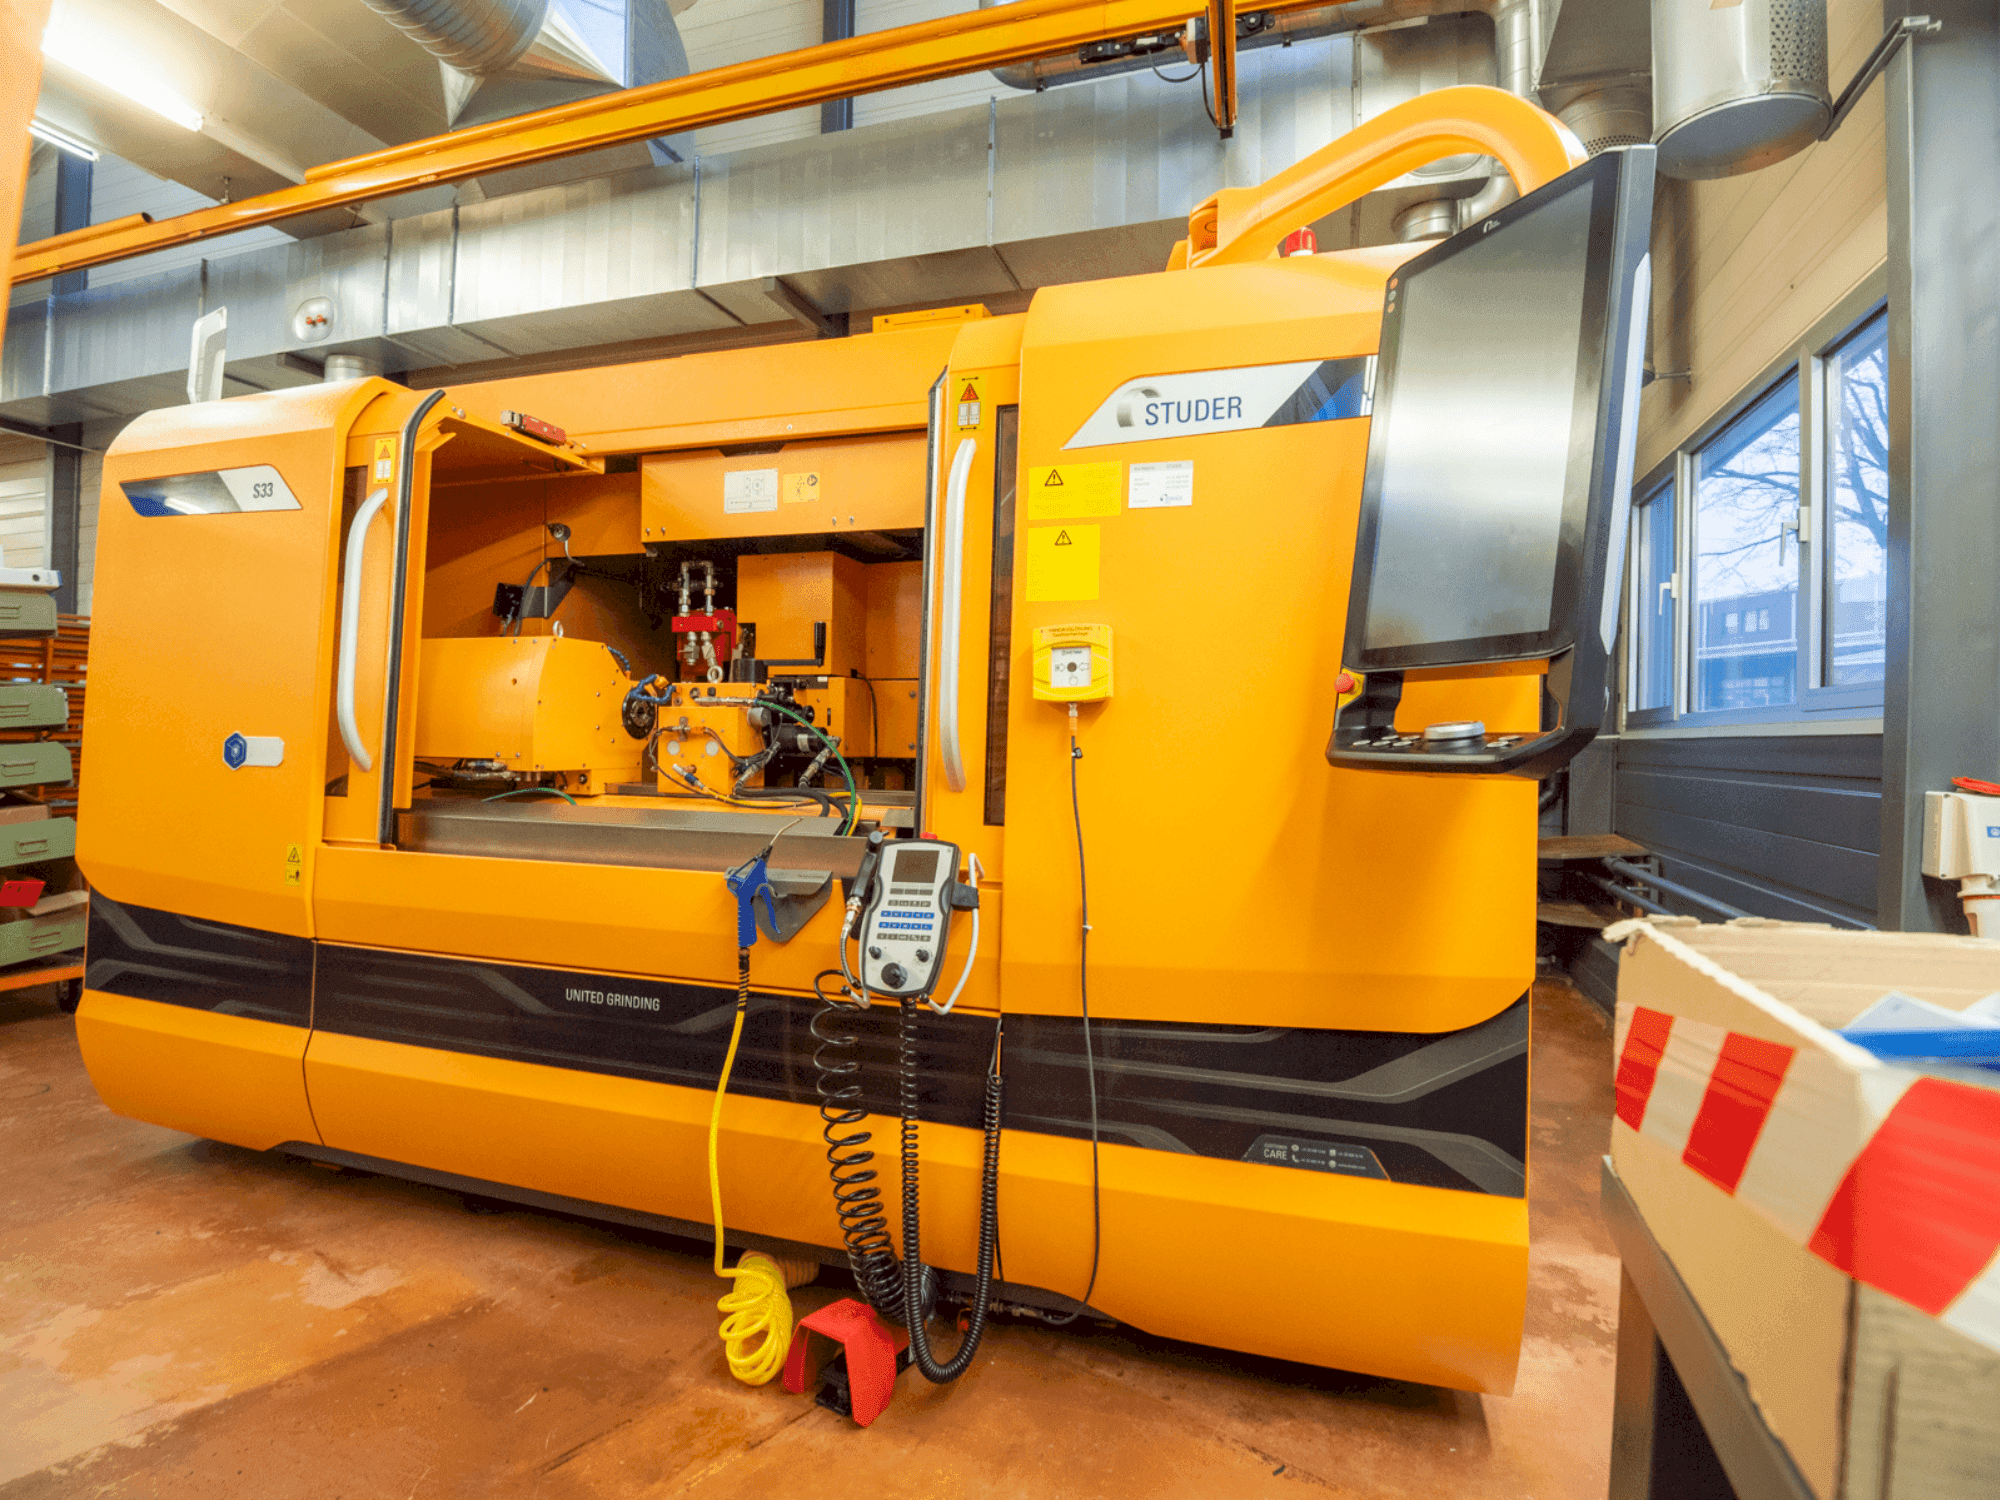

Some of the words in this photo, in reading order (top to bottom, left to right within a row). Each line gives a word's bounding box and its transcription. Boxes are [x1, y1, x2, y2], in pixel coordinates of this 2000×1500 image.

[1145, 396, 1242, 426] STUDER
[253, 482, 274, 498] S33
[565, 988, 604, 1004] UNITED
[606, 992, 660, 1011] GRINDING
[1263, 1148, 1288, 1160] CARE
